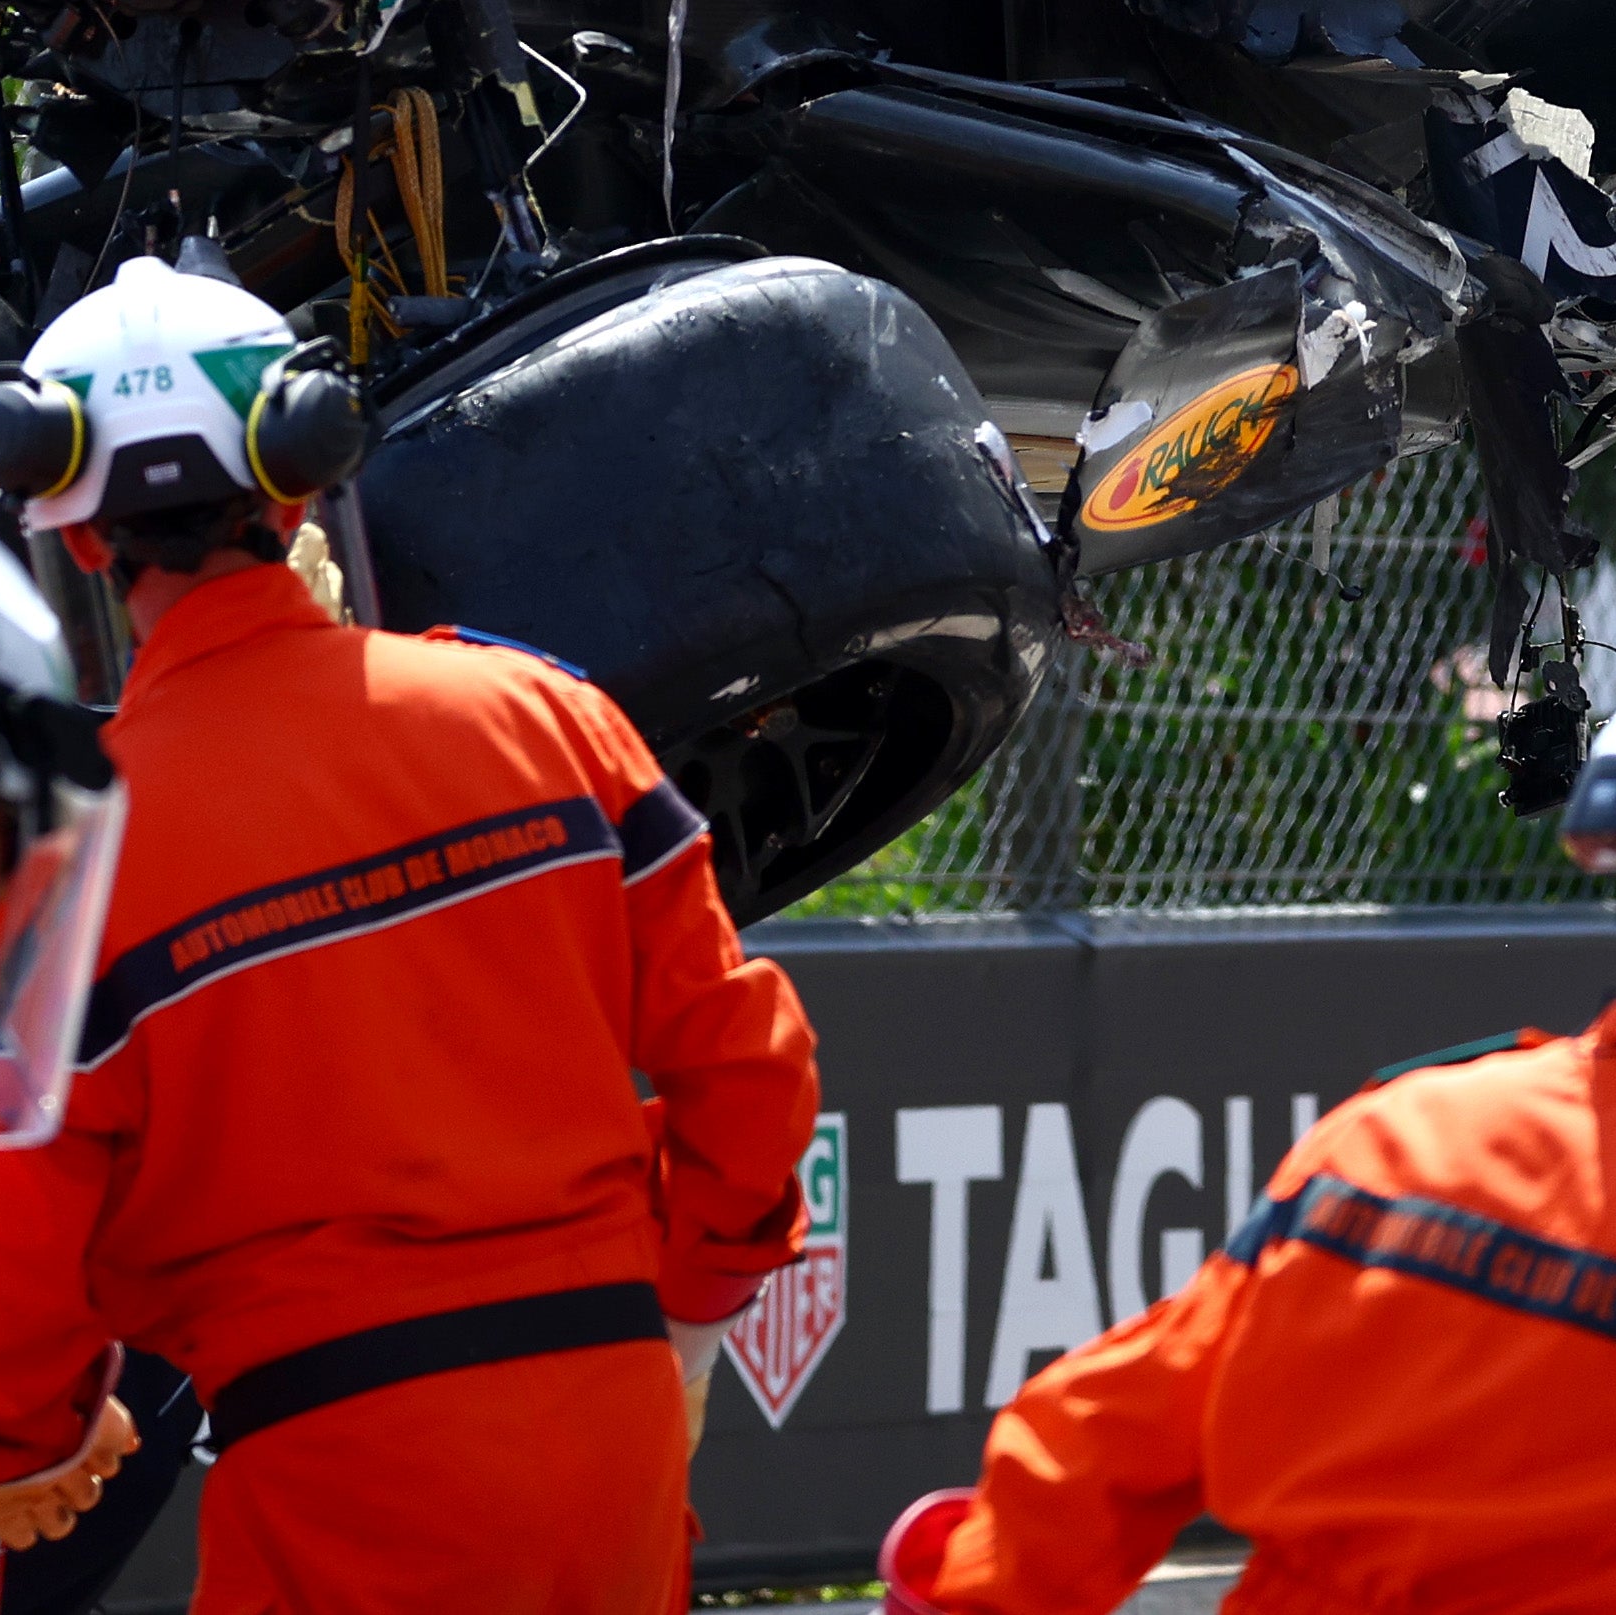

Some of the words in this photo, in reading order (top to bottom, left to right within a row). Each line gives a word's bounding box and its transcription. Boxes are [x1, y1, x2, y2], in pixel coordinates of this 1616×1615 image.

[113, 365, 174, 399] 478
[1139, 385, 1270, 496] RAUCH
[170, 882, 343, 974] AUTOMOBILE
[341, 863, 406, 911] CLUB
[403, 849, 446, 891] DE
[444, 815, 568, 878] MONACO
